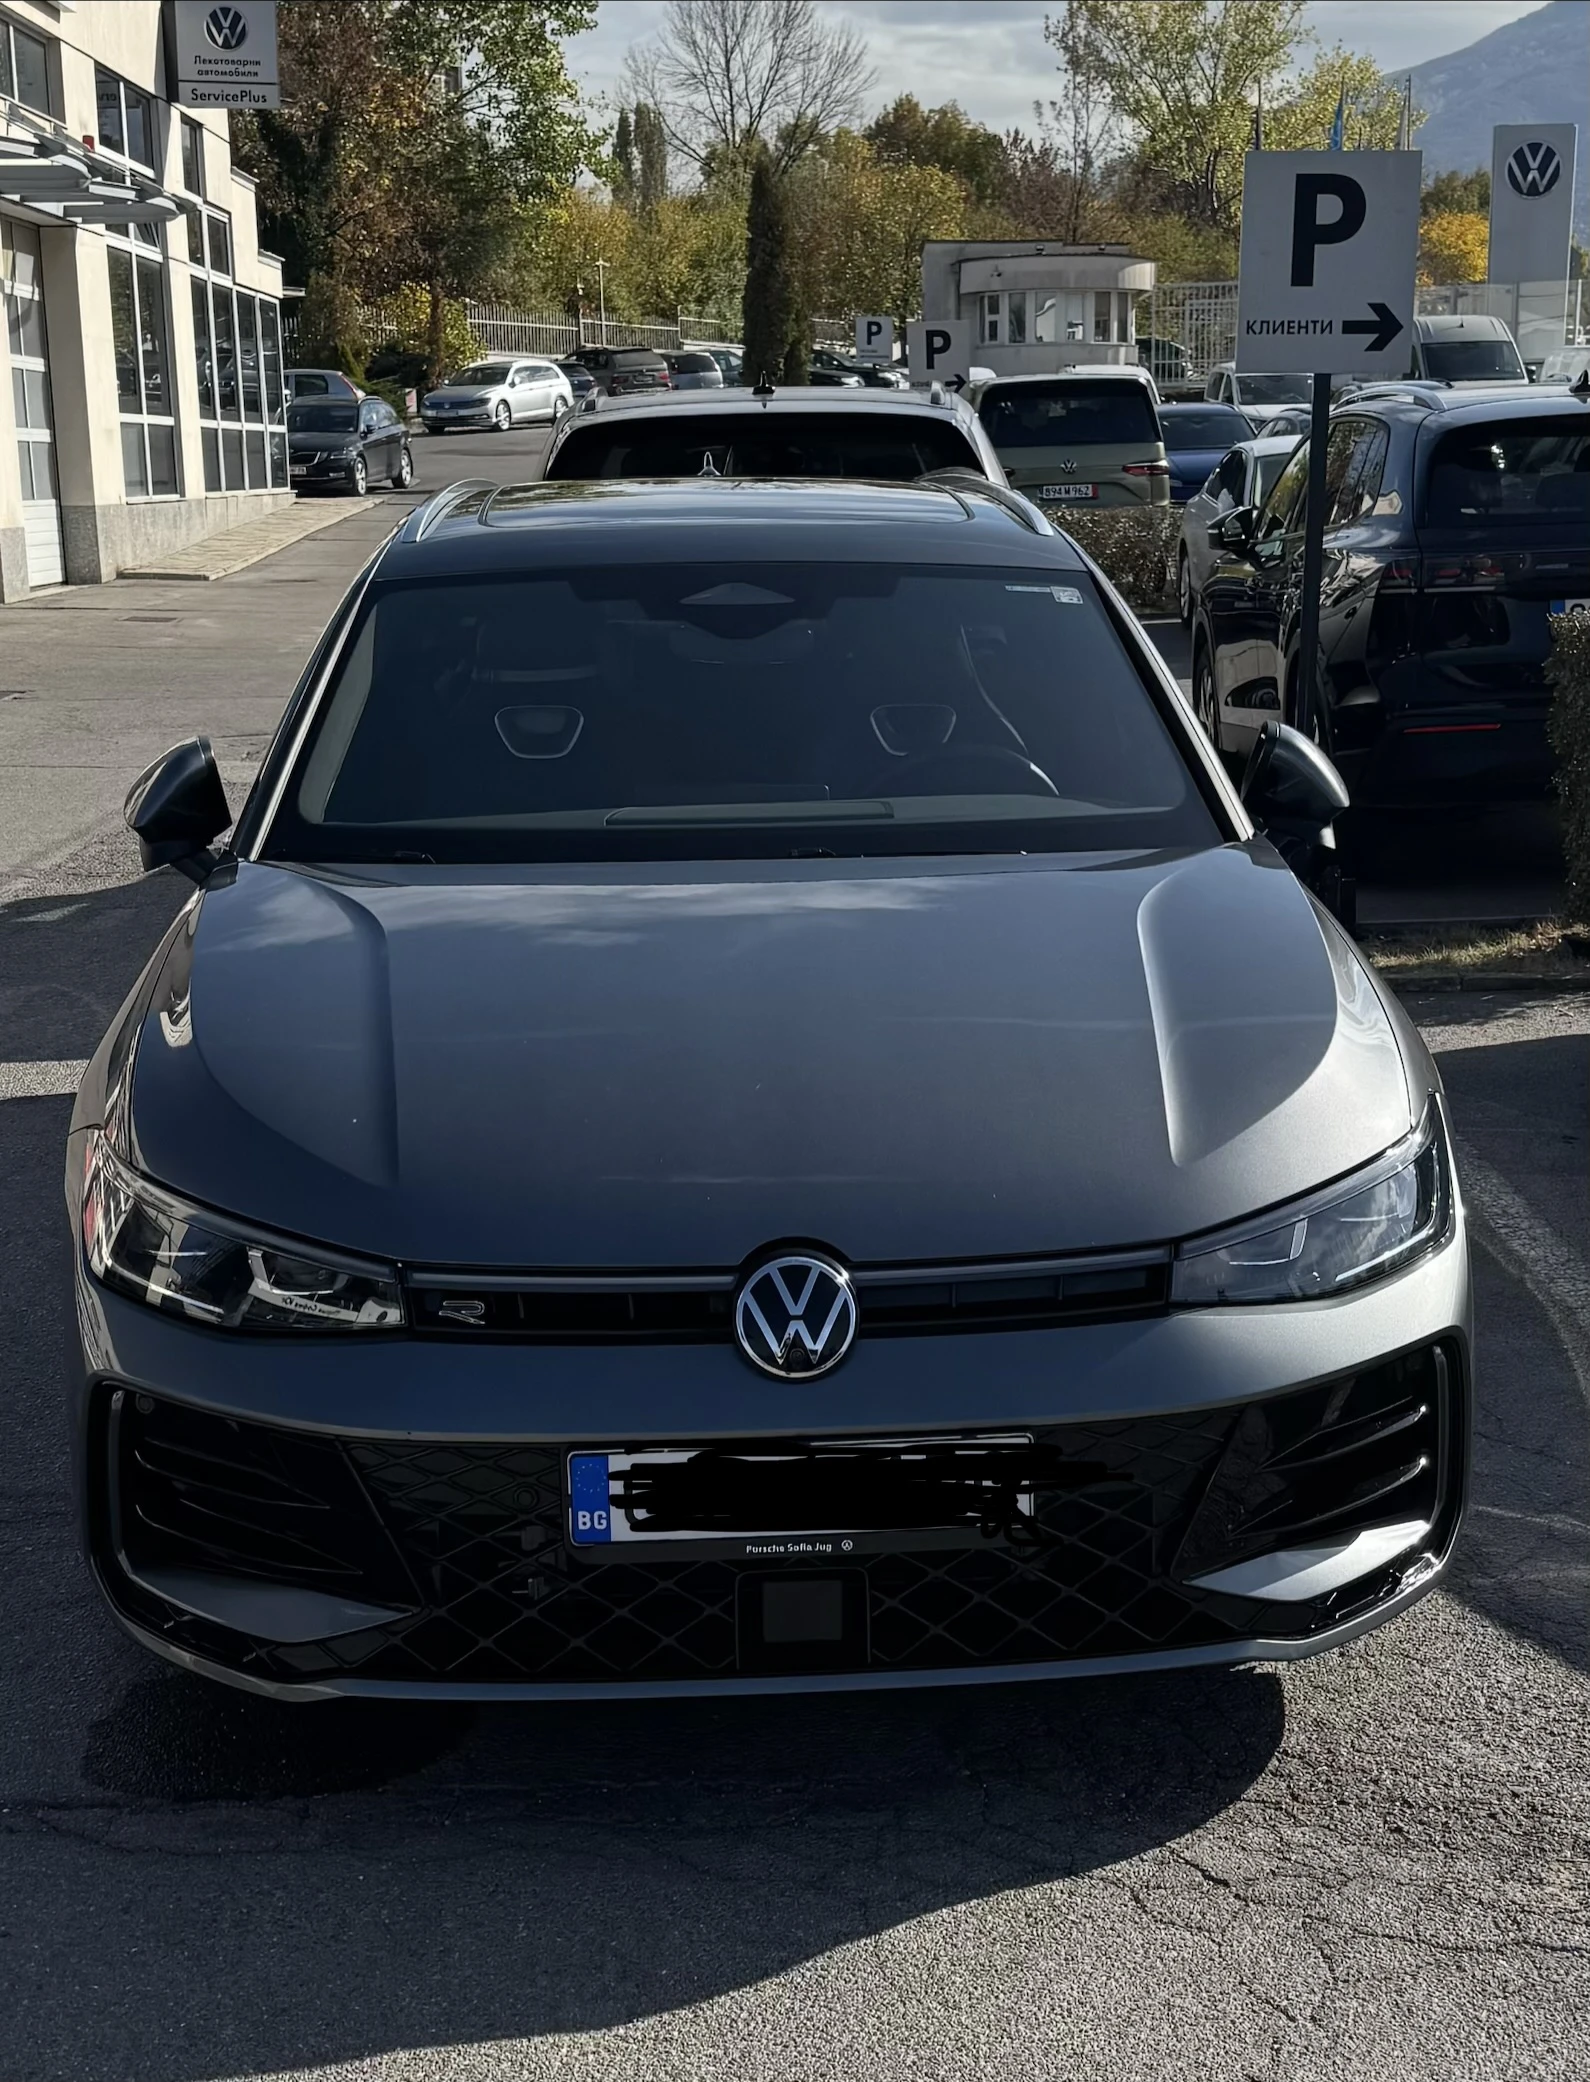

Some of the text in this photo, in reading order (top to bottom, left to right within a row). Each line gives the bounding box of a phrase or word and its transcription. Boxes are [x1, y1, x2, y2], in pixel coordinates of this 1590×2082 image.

[204, 6, 248, 51] VW
[194, 55, 261, 68] Лекотоварни
[197, 67, 259, 77] автомобили
[191, 88, 267, 103] ServicePlus
[1505, 140, 1562, 199] VW
[1291, 173, 1367, 287] P
[867, 321, 882, 345] P
[1246, 319, 1334, 336] КЛИЕНТИ
[925, 329, 952, 370] P
[736, 1256, 856, 1378] VW
[577, 1510, 608, 1531] BG
[746, 1544, 785, 1554] Porsche
[787, 1543, 813, 1552] Sofia
[814, 1542, 832, 1553] Jug
